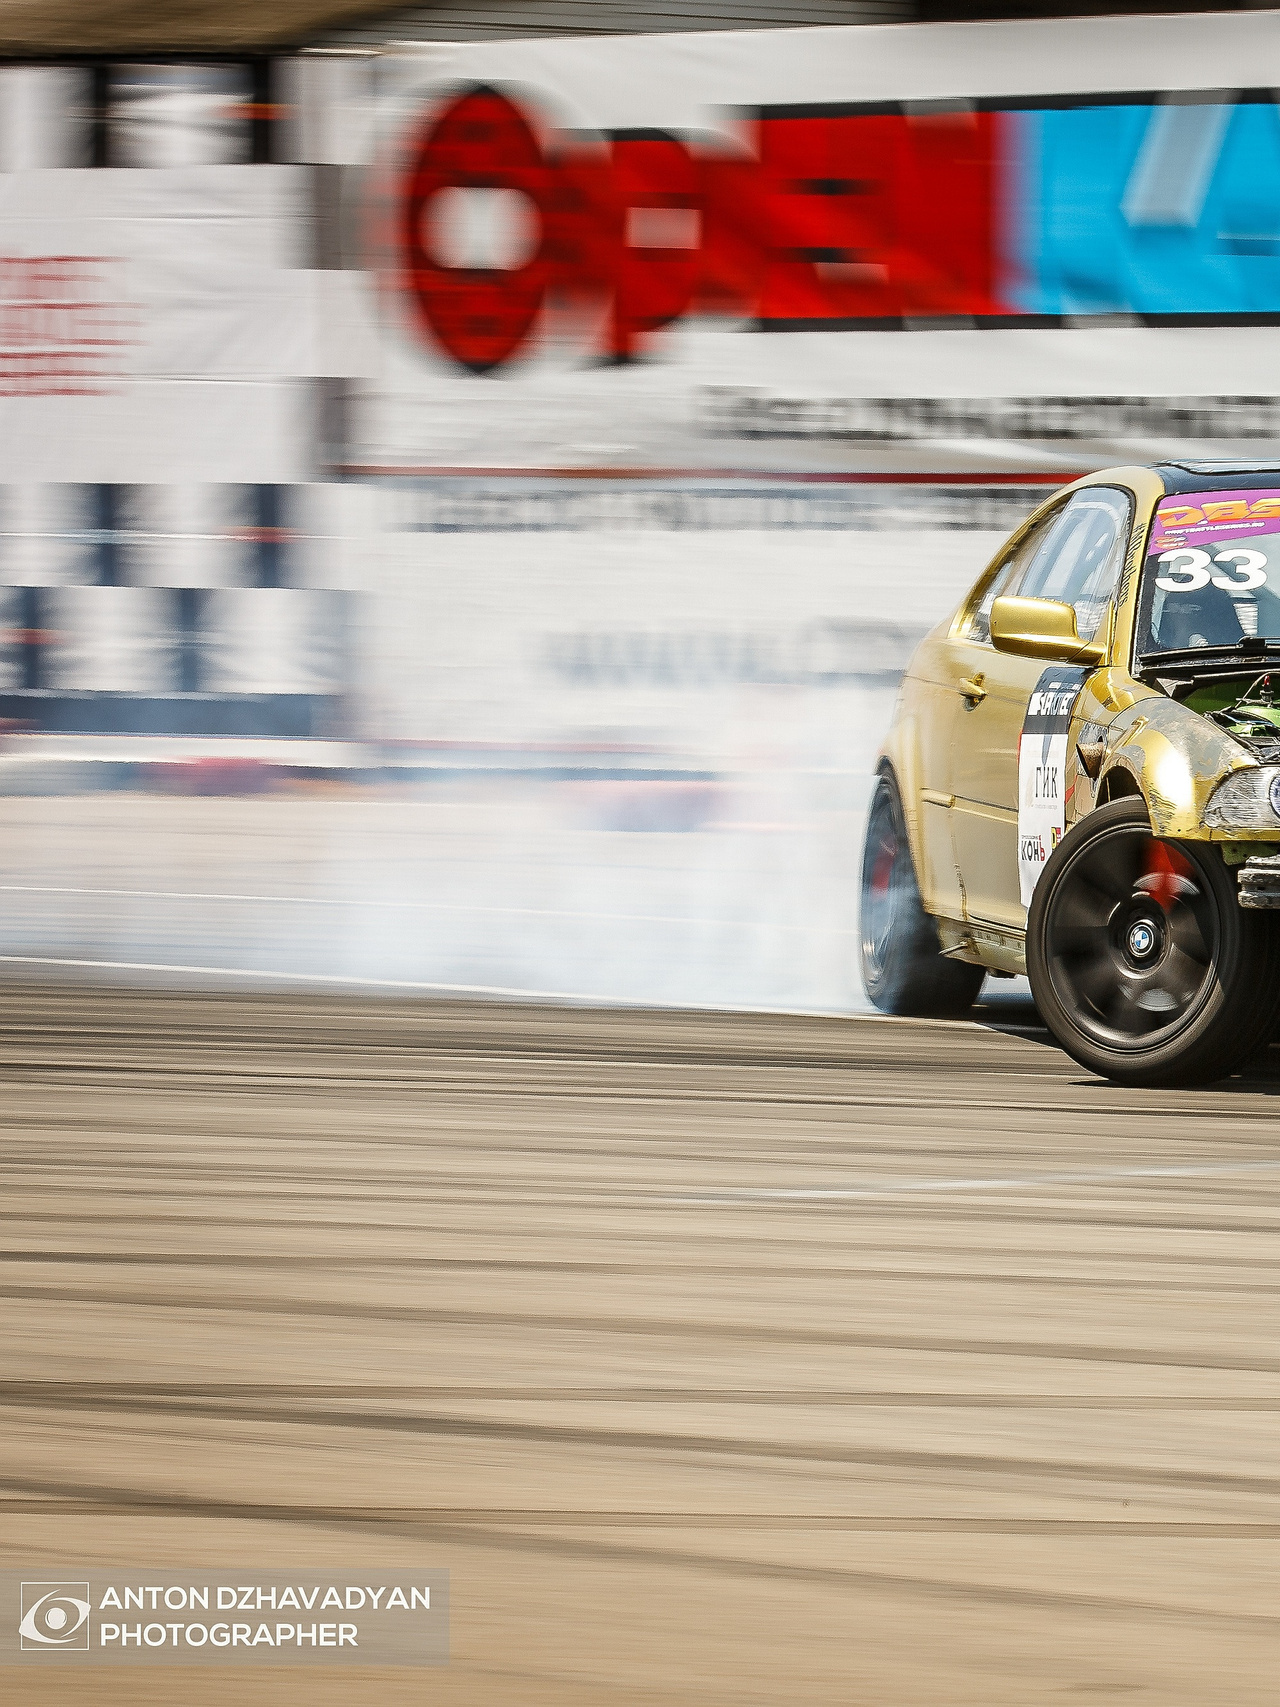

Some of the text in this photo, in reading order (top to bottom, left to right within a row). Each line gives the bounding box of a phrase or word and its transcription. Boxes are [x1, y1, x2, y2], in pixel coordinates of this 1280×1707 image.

[1155, 549, 1268, 592] 33
[1035, 766, 1058, 798] ГИК
[1021, 840, 1046, 861] КОНЬ
